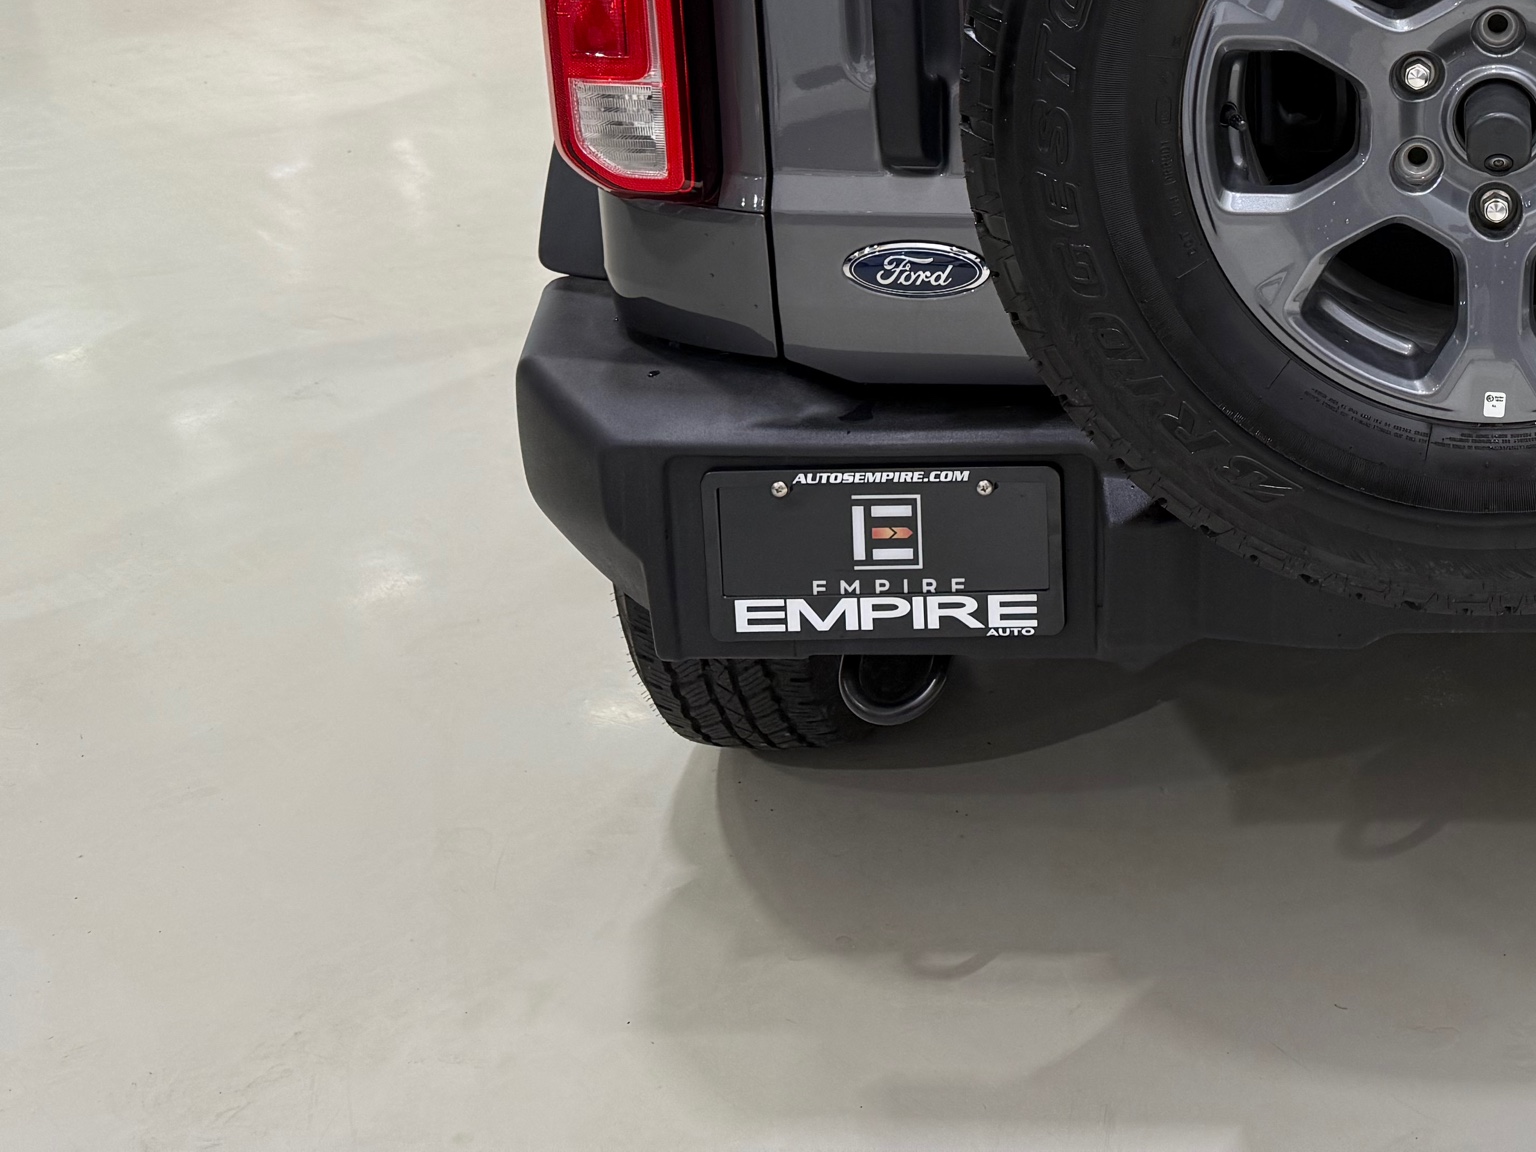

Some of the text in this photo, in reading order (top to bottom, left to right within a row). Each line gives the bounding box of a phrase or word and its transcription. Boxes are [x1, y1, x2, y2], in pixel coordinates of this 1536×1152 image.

[876, 254, 954, 286] Ford
[792, 470, 971, 485] AUTOSEMPIRE.COM
[734, 595, 1038, 633] EMPIRE
[986, 627, 1036, 637] AUTO
